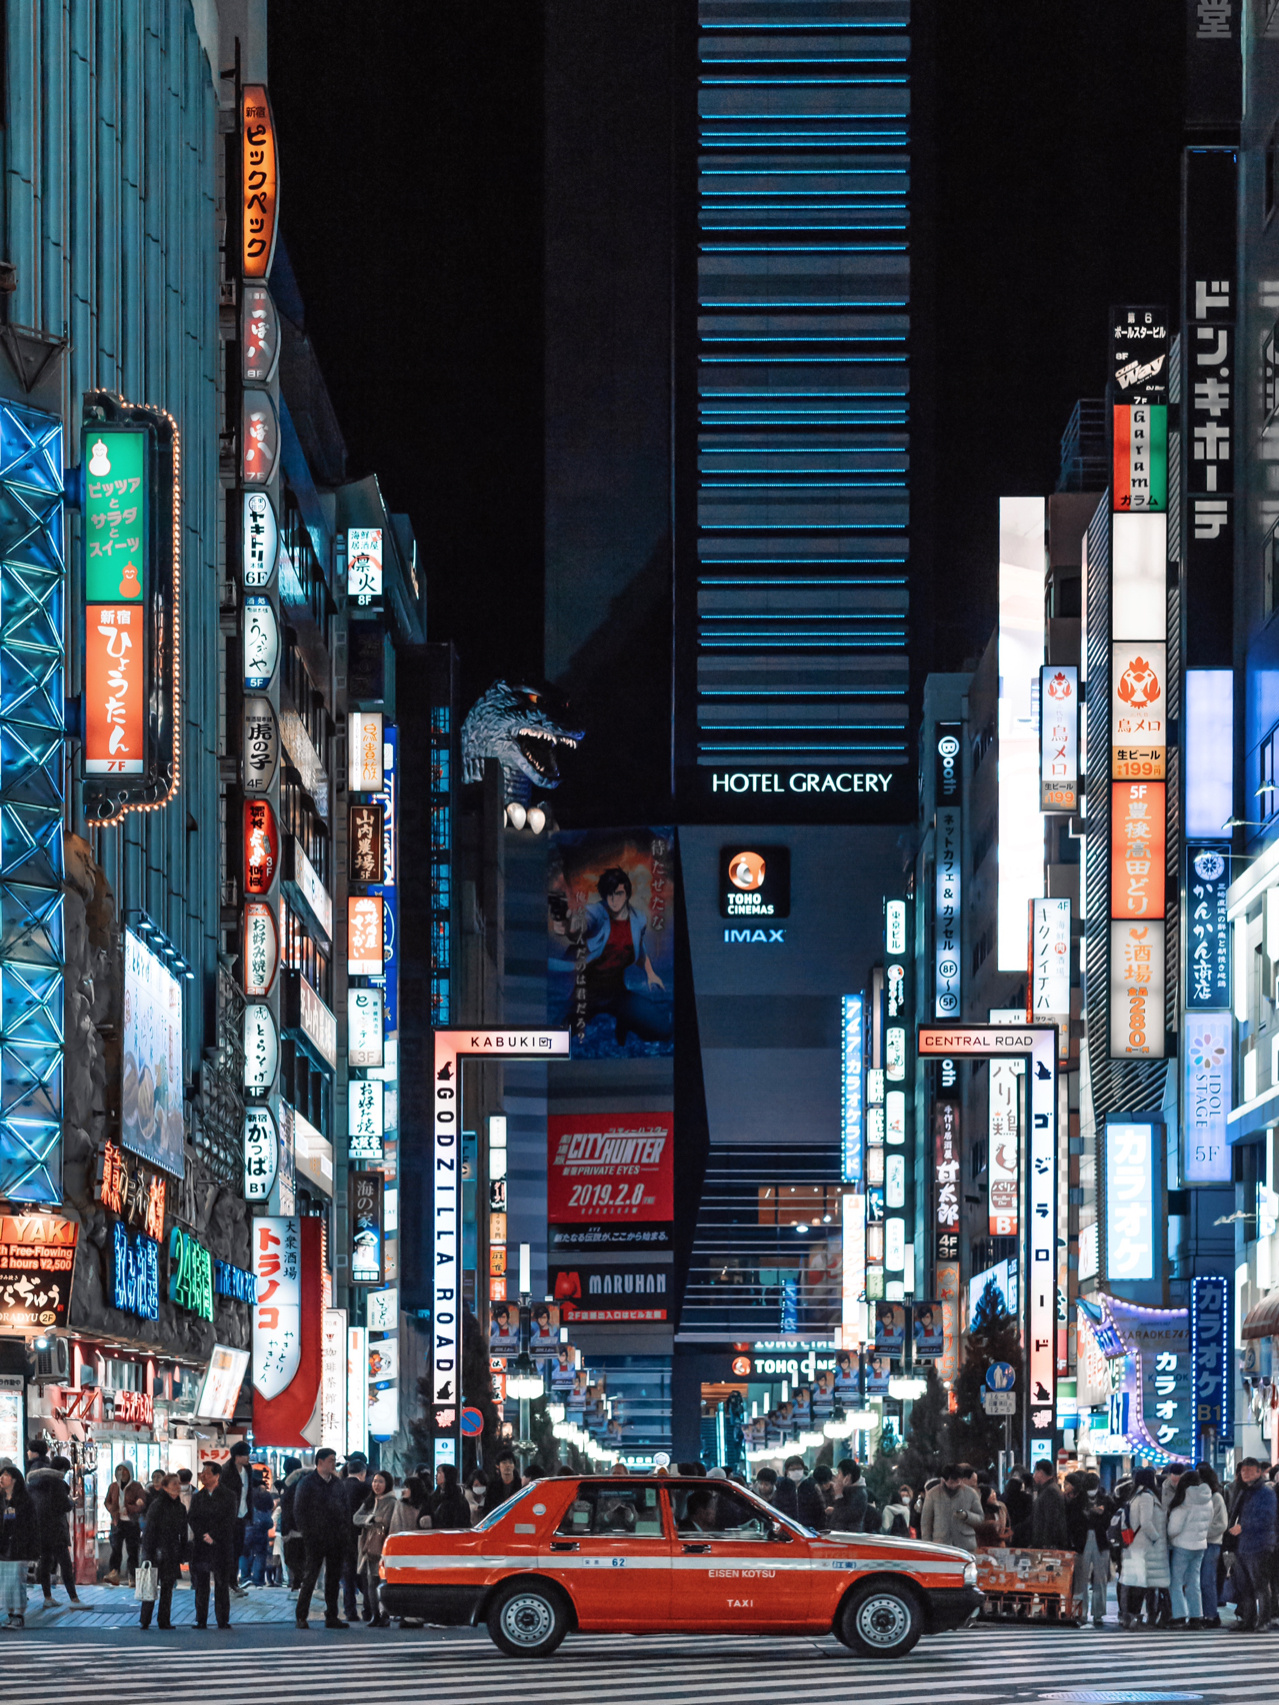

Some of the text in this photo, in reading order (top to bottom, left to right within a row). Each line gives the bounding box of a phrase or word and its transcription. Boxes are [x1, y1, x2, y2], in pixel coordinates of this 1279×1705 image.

[245, 105, 267, 119] 新宿
[1116, 354, 1165, 390] Way
[1133, 396, 1147, 404] 7F
[1194, 280, 1229, 539] ドン・キホーラ
[109, 498, 119, 508] と
[1120, 494, 1159, 506] ガラム
[91, 507, 137, 529] サラダ
[109, 528, 119, 538] と
[89, 537, 140, 558] スイーツ
[245, 571, 268, 585] 6F
[358, 595, 372, 605] 8F
[100, 609, 131, 625] 新宿
[97, 625, 133, 756] ひょうたん
[250, 679, 264, 687] 5F
[1117, 718, 1161, 733] 鳥メロ
[248, 724, 273, 770] 虎の子
[363, 723, 378, 781] 鳥貴族
[1051, 724, 1068, 776] 鳥メロ
[1117, 750, 1161, 761] 生ビール
[107, 761, 126, 771] 7F
[247, 779, 263, 789] 4F
[712, 773, 893, 793] HOTEL GRACERY
[1130, 785, 1147, 799] 5F
[355, 809, 376, 872] 山内農場
[1124, 801, 1152, 914] 豊後高田どり
[650, 839, 665, 931] 待たせたな
[727, 893, 762, 905] TOHO
[1057, 901, 1068, 911] 4F
[727, 905, 774, 915] CINEMAS
[724, 929, 785, 943] IMAX
[252, 918, 267, 986] お好み焼き
[942, 964, 954, 973] 8F
[1124, 943, 1153, 984] 酒場
[942, 998, 954, 1007] 5F
[1128, 996, 1146, 1047] 280
[925, 1036, 1033, 1046] CENTRAL ROAD
[358, 1052, 375, 1063] 3F
[941, 1058, 956, 1087] oth
[250, 1087, 265, 1097] 1F
[1209, 1074, 1221, 1118] IDOL
[1195, 1074, 1208, 1128] STAGE
[248, 1113, 268, 1123] 新宿
[845, 1060, 861, 1173] カラオケランド
[247, 1123, 268, 1177] かっぱ
[566, 1133, 666, 1164] CITY HUNTER
[1195, 1145, 1219, 1162] 5F
[616, 1165, 640, 1175] EYES
[250, 1183, 266, 1193] B1
[568, 1183, 645, 1206] 2019.2.8
[936, 1158, 960, 1226] 甘太郎
[356, 1181, 375, 1228] 海の家
[1113, 1129, 1148, 1273] カラオケ
[13, 1221, 75, 1244] YAKI
[436, 1087, 455, 1371] GODZILLA ROAD
[1034, 1113, 1053, 1352] ゴジラロード
[939, 1235, 957, 1246] 4F
[10, 1246, 73, 1259] Free-Flowing
[283, 1220, 298, 1280] 大衆酒場
[939, 1248, 957, 1258] 3F
[9, 1258, 38, 1269] hours
[40, 1260, 72, 1271] ¥2,500
[257, 1227, 282, 1330] トラノコ
[589, 1273, 666, 1294] MARUHAN
[42, 1313, 54, 1322] 2F
[1198, 1284, 1223, 1398] カラオケ
[754, 1359, 798, 1374] TOHO
[1154, 1351, 1179, 1445] カラオケ
[1197, 1404, 1221, 1421] B1
[611, 1558, 625, 1567] 62
[708, 1569, 776, 1578] EISEN KOTSU
[726, 1599, 754, 1608] TAXI
